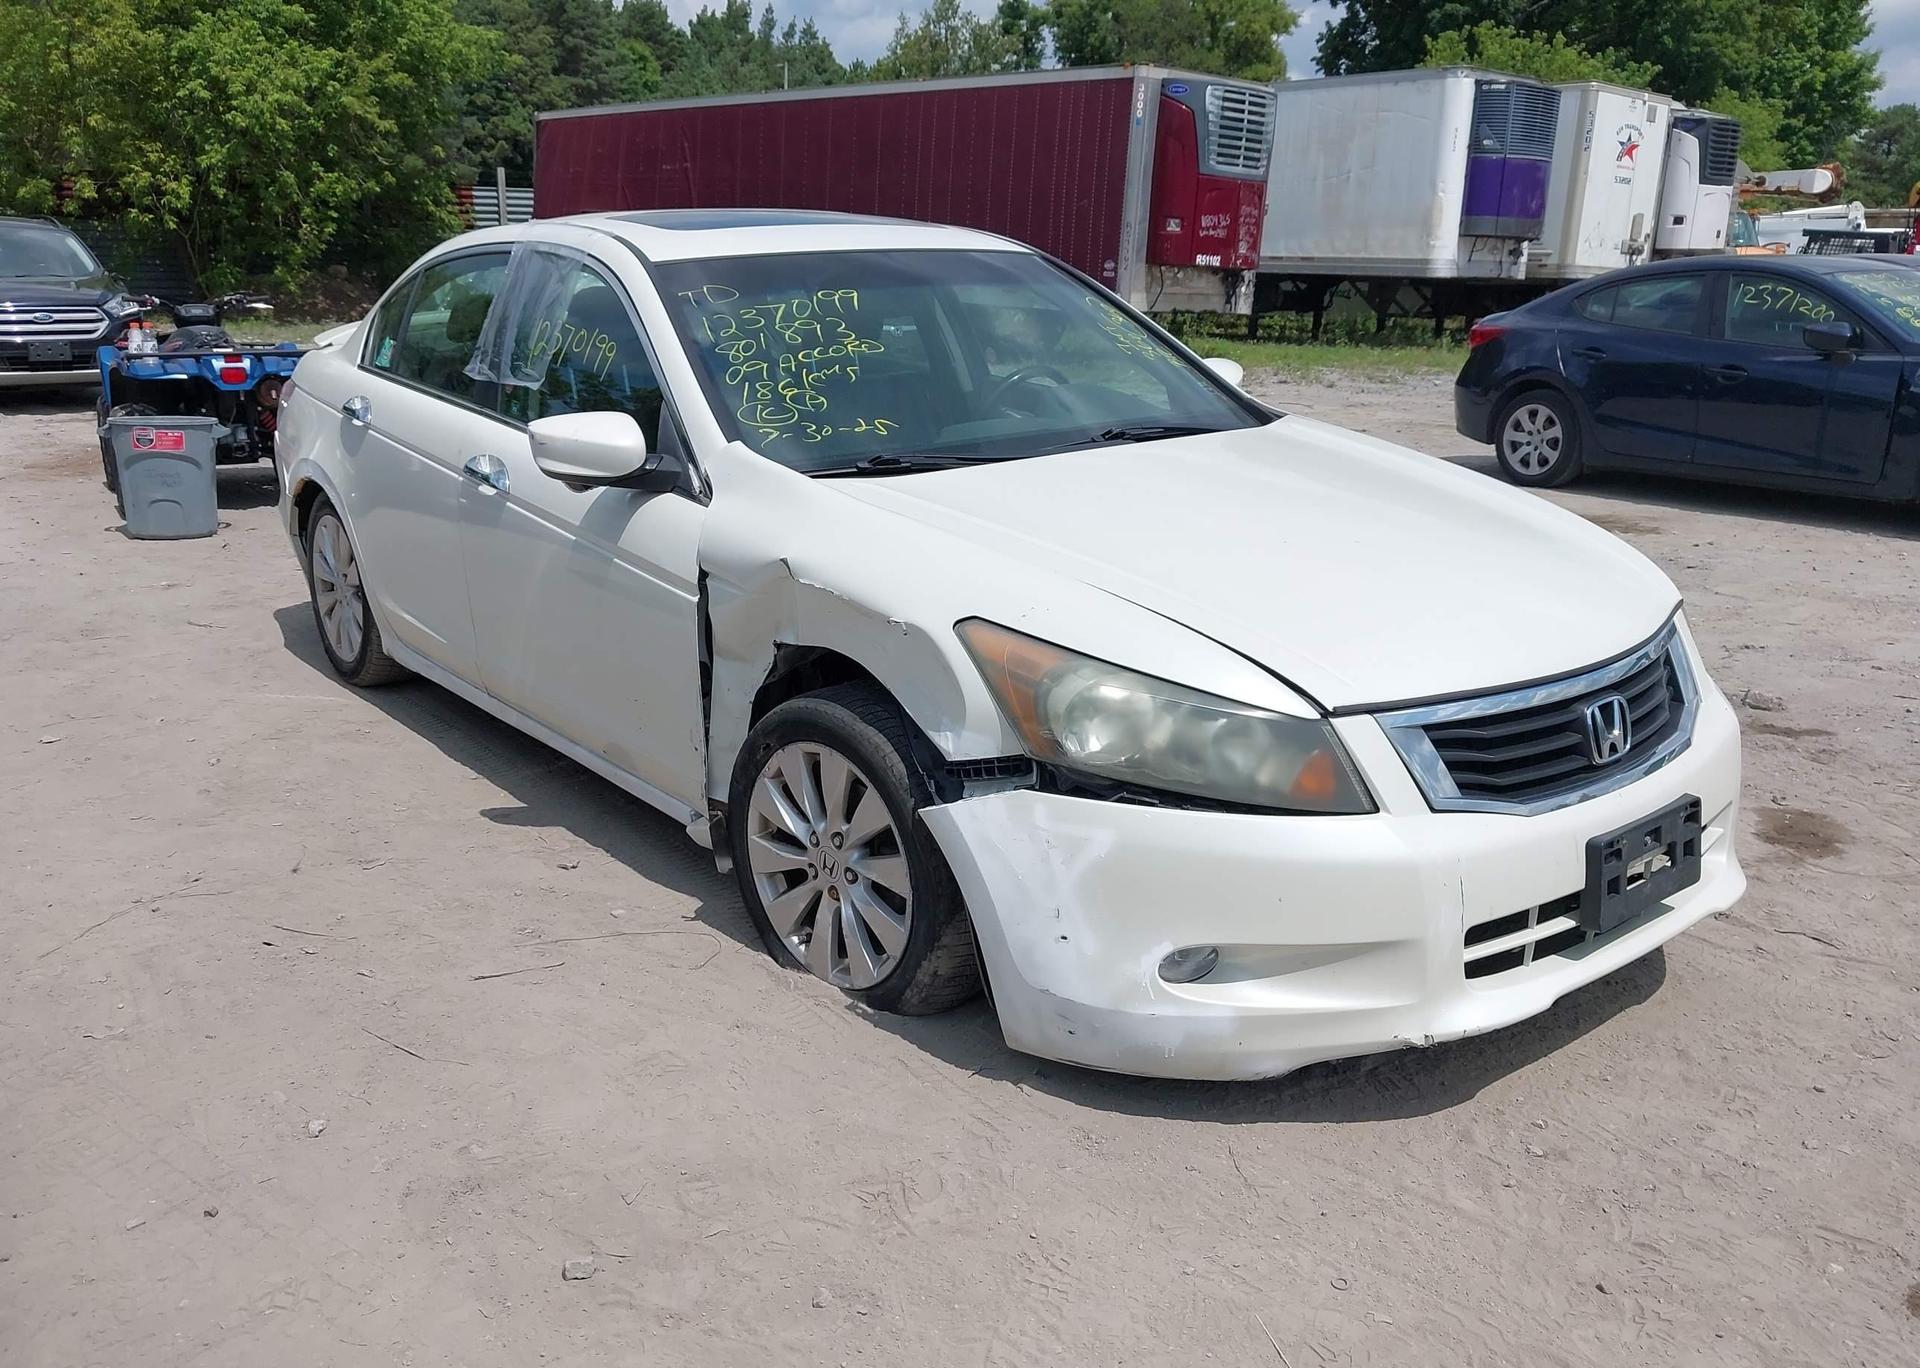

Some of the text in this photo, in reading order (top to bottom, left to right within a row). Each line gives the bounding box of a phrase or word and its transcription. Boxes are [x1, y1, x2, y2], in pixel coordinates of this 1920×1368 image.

[1195, 254, 1221, 267] R51102
[678, 284, 740, 308] TD
[1733, 283, 1836, 323] 12371200
[702, 289, 859, 343] 12370199
[527, 318, 617, 383] 12370199
[725, 360, 769, 385] 09
